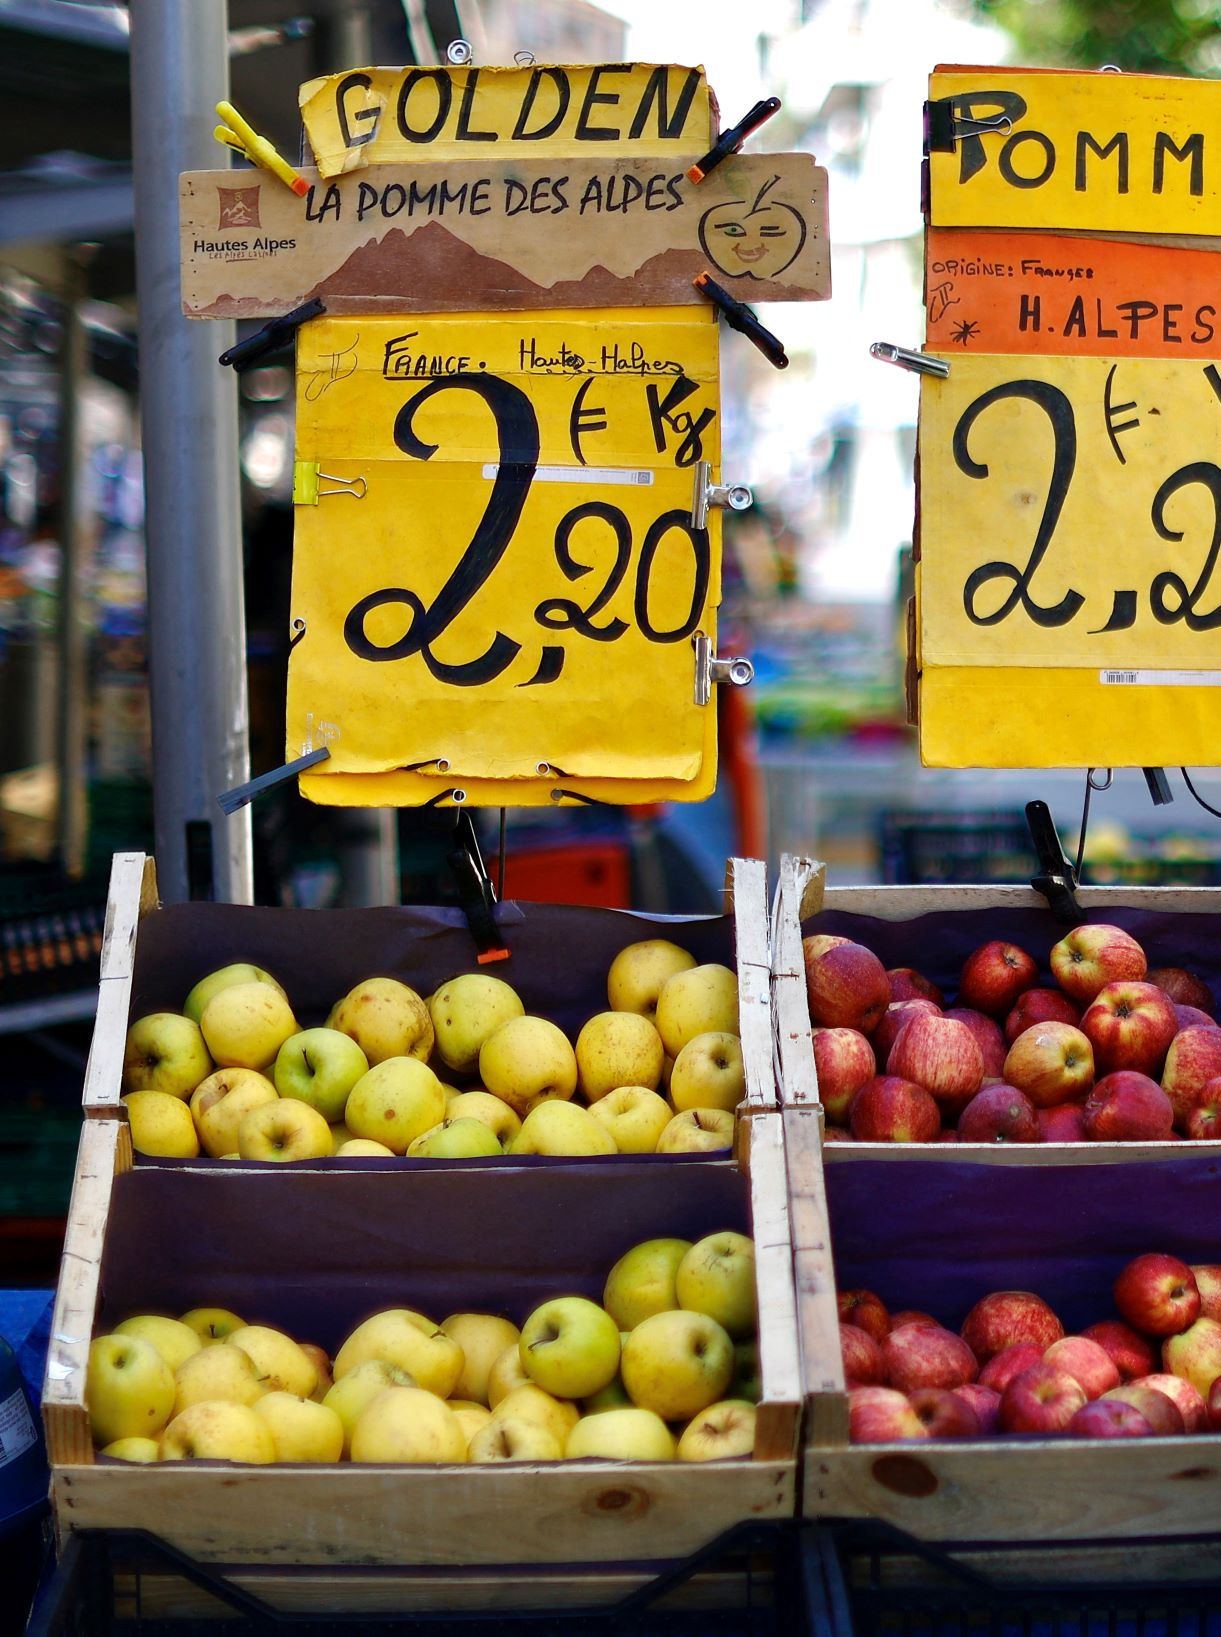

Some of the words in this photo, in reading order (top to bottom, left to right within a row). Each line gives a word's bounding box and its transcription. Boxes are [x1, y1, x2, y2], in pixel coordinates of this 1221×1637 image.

[336, 65, 704, 148] GOLDEN
[305, 183, 342, 223] LA
[356, 179, 492, 221] POMME
[504, 178, 569, 217] DES
[579, 172, 685, 213] ALPES
[194, 240, 248, 252] Hautes
[253, 237, 296, 253] Alpes
[646, 375, 716, 467] Kg
